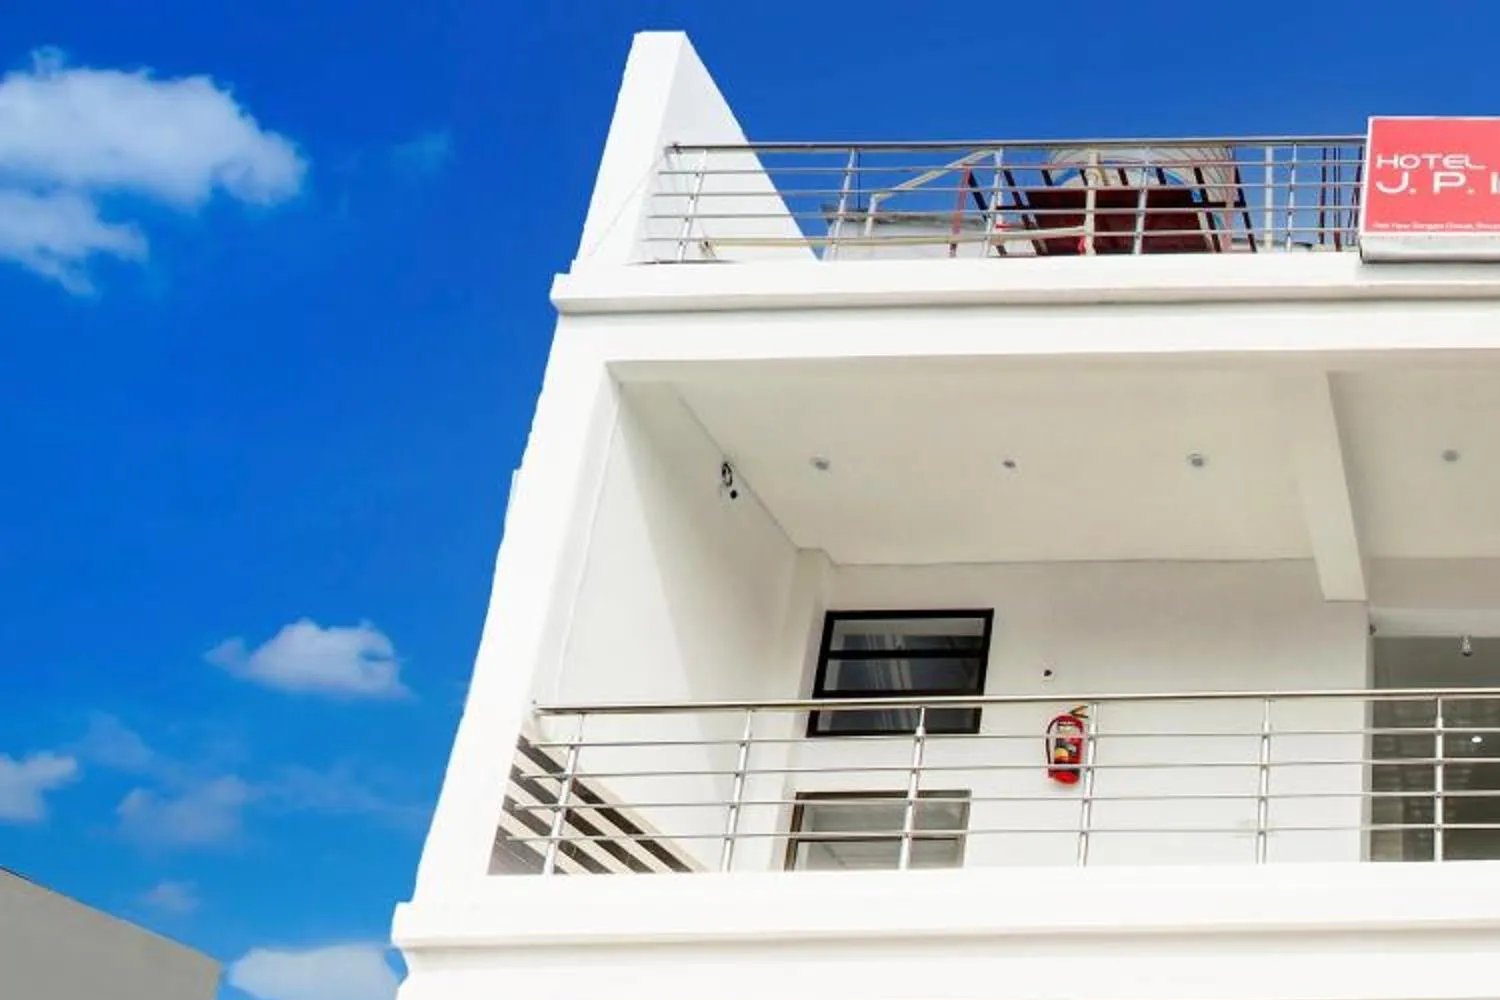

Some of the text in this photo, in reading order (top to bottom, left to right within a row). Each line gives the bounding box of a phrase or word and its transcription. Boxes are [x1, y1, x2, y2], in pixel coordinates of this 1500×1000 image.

[1375, 153, 1487, 170] HOTEL
[1375, 171, 1417, 195] J.
[1432, 171, 1475, 195] P.
